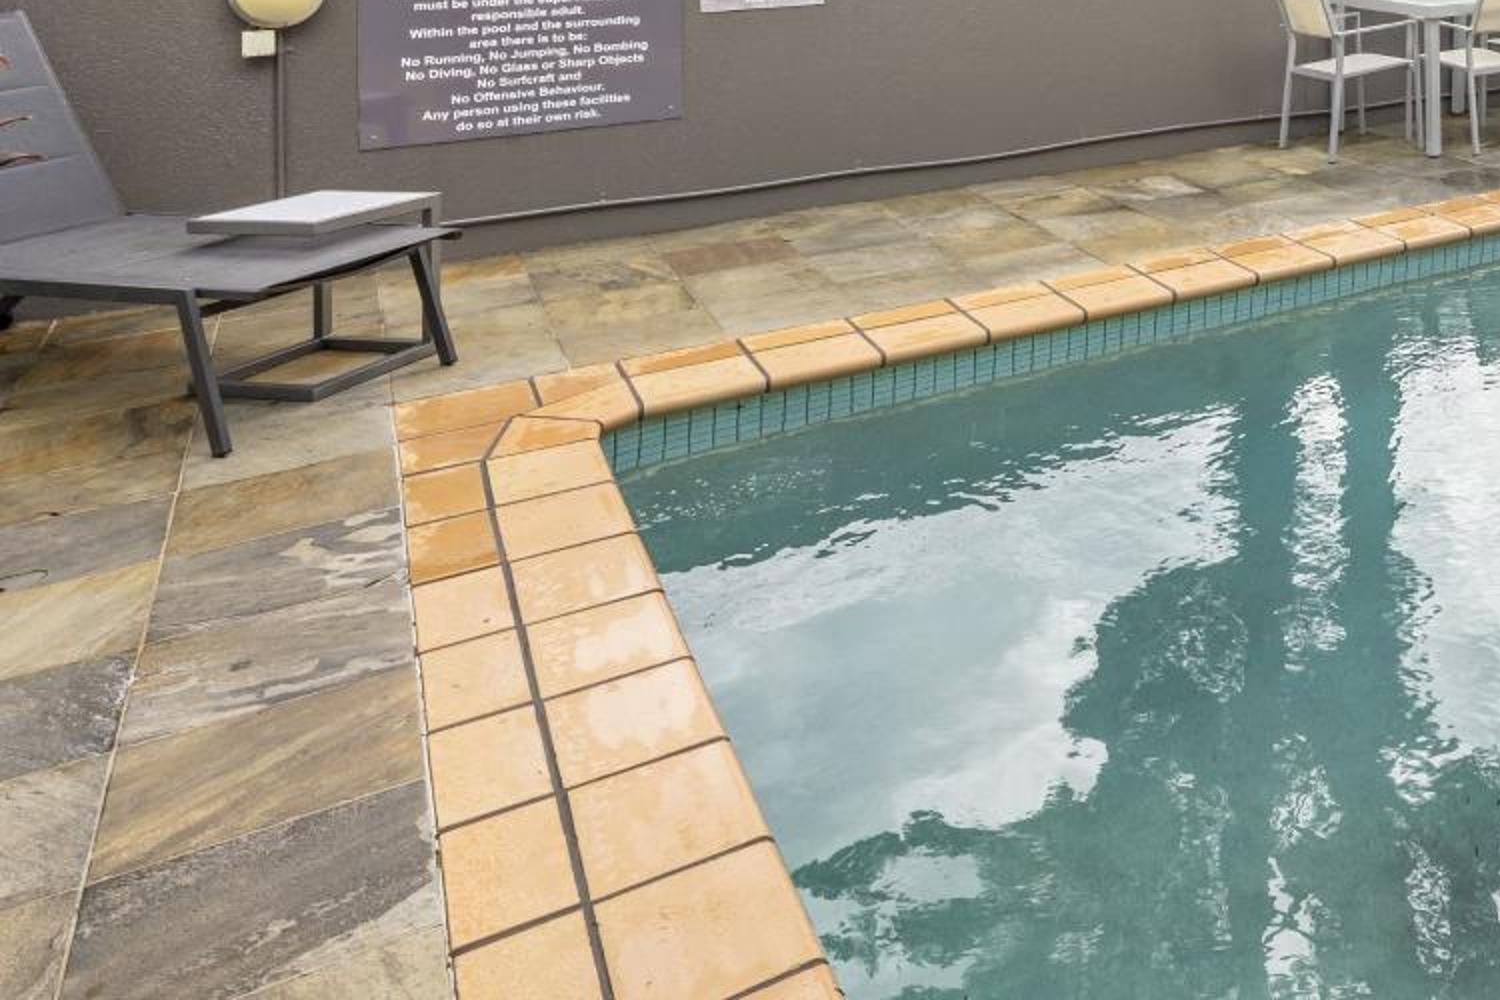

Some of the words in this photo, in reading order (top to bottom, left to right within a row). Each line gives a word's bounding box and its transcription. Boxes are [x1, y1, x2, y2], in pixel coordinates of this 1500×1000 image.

[413, 1, 448, 11] must
[452, 0, 469, 9] be
[471, 8, 547, 21] responsible
[551, 5, 586, 16] adult.
[409, 27, 453, 39] Within
[457, 26, 478, 36] the
[481, 23, 511, 36] pool
[515, 21, 538, 31] and
[541, 19, 562, 30] the
[565, 15, 640, 28] surrounding
[469, 38, 497, 49] area
[501, 34, 534, 46] there
[537, 34, 548, 43] is
[552, 33, 565, 42] to
[568, 32, 588, 41] be:
[401, 57, 421, 67] No
[424, 53, 485, 65] Running,
[489, 50, 507, 61] No
[573, 43, 590, 54] No
[594, 40, 649, 52] Bombing
[405, 71, 425, 81] No
[479, 65, 498, 75] No
[501, 62, 538, 73] Glass
[541, 61, 556, 70] or
[558, 58, 595, 69] Sharp
[598, 53, 645, 66] Objects
[477, 79, 496, 88] No
[499, 73, 555, 87] Surfcraft
[558, 72, 582, 81] and
[451, 94, 470, 104] No
[473, 90, 536, 103] Offensive
[422, 110, 449, 121] Any
[453, 107, 499, 120] person
[503, 102, 539, 114] using
[542, 98, 576, 109] these
[579, 93, 631, 105] facilities
[456, 122, 473, 132] do
[477, 120, 493, 129] so
[496, 117, 509, 127] at
[512, 115, 542, 125] their
[545, 112, 571, 122] own
